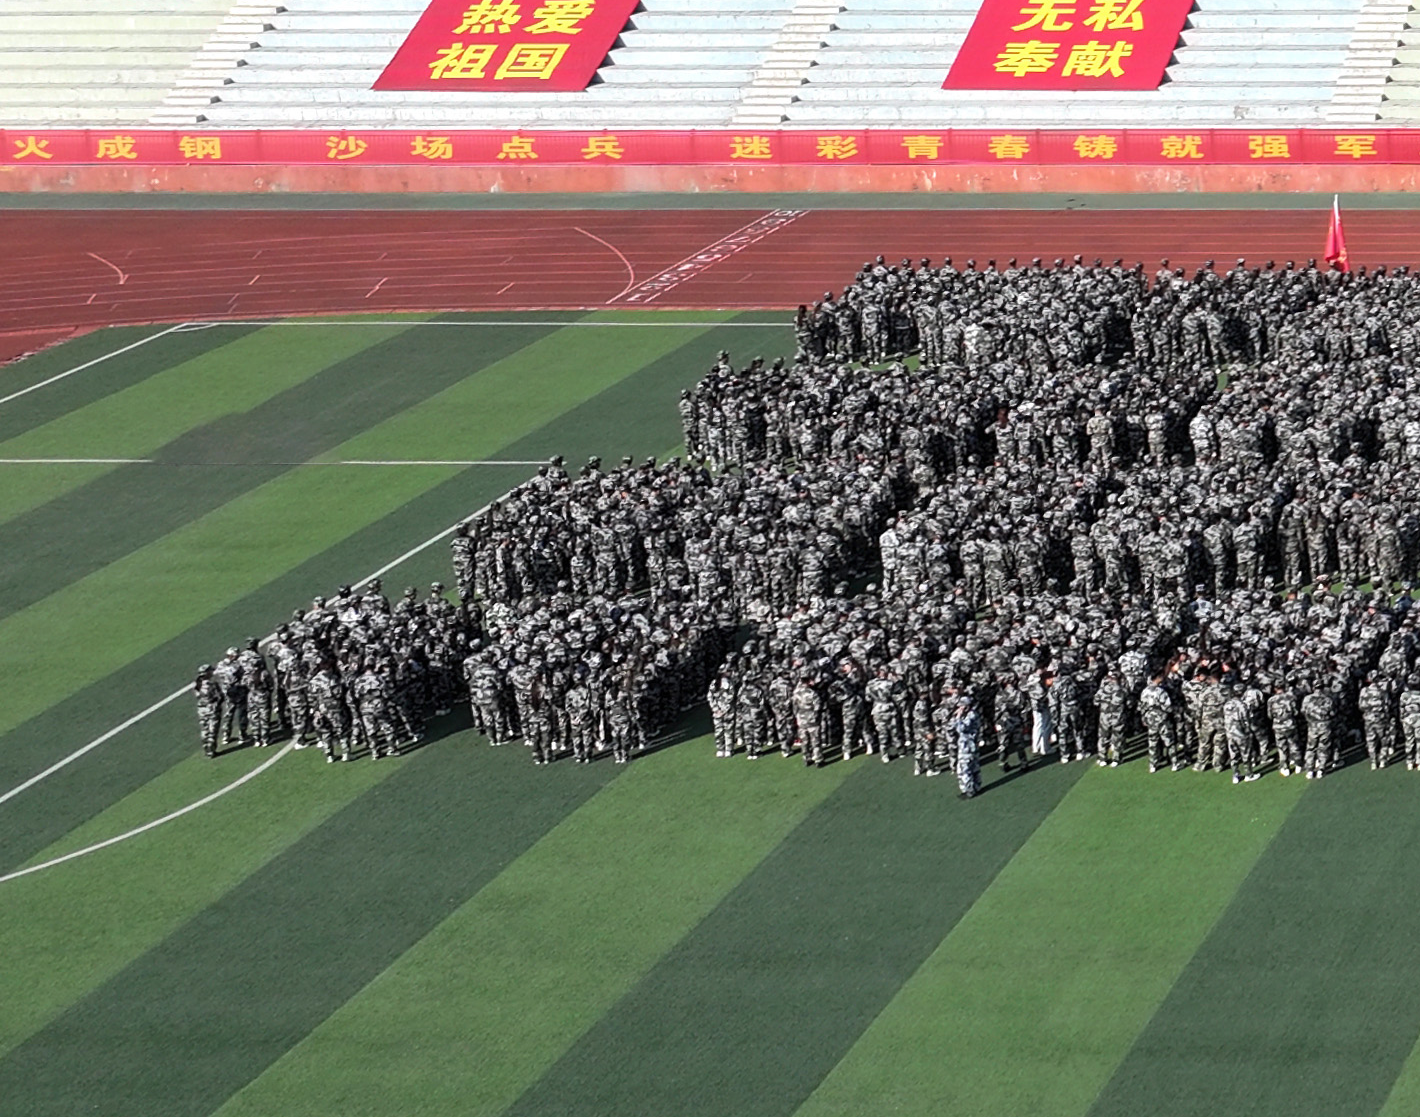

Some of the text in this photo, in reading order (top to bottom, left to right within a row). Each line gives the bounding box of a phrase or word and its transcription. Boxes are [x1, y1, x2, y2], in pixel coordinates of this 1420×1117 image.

[428, 42, 571, 80] 祖国
[993, 40, 1134, 78] 奉献
[13, 135, 222, 159] 火成钢
[326, 135, 625, 159] 沙场点兵
